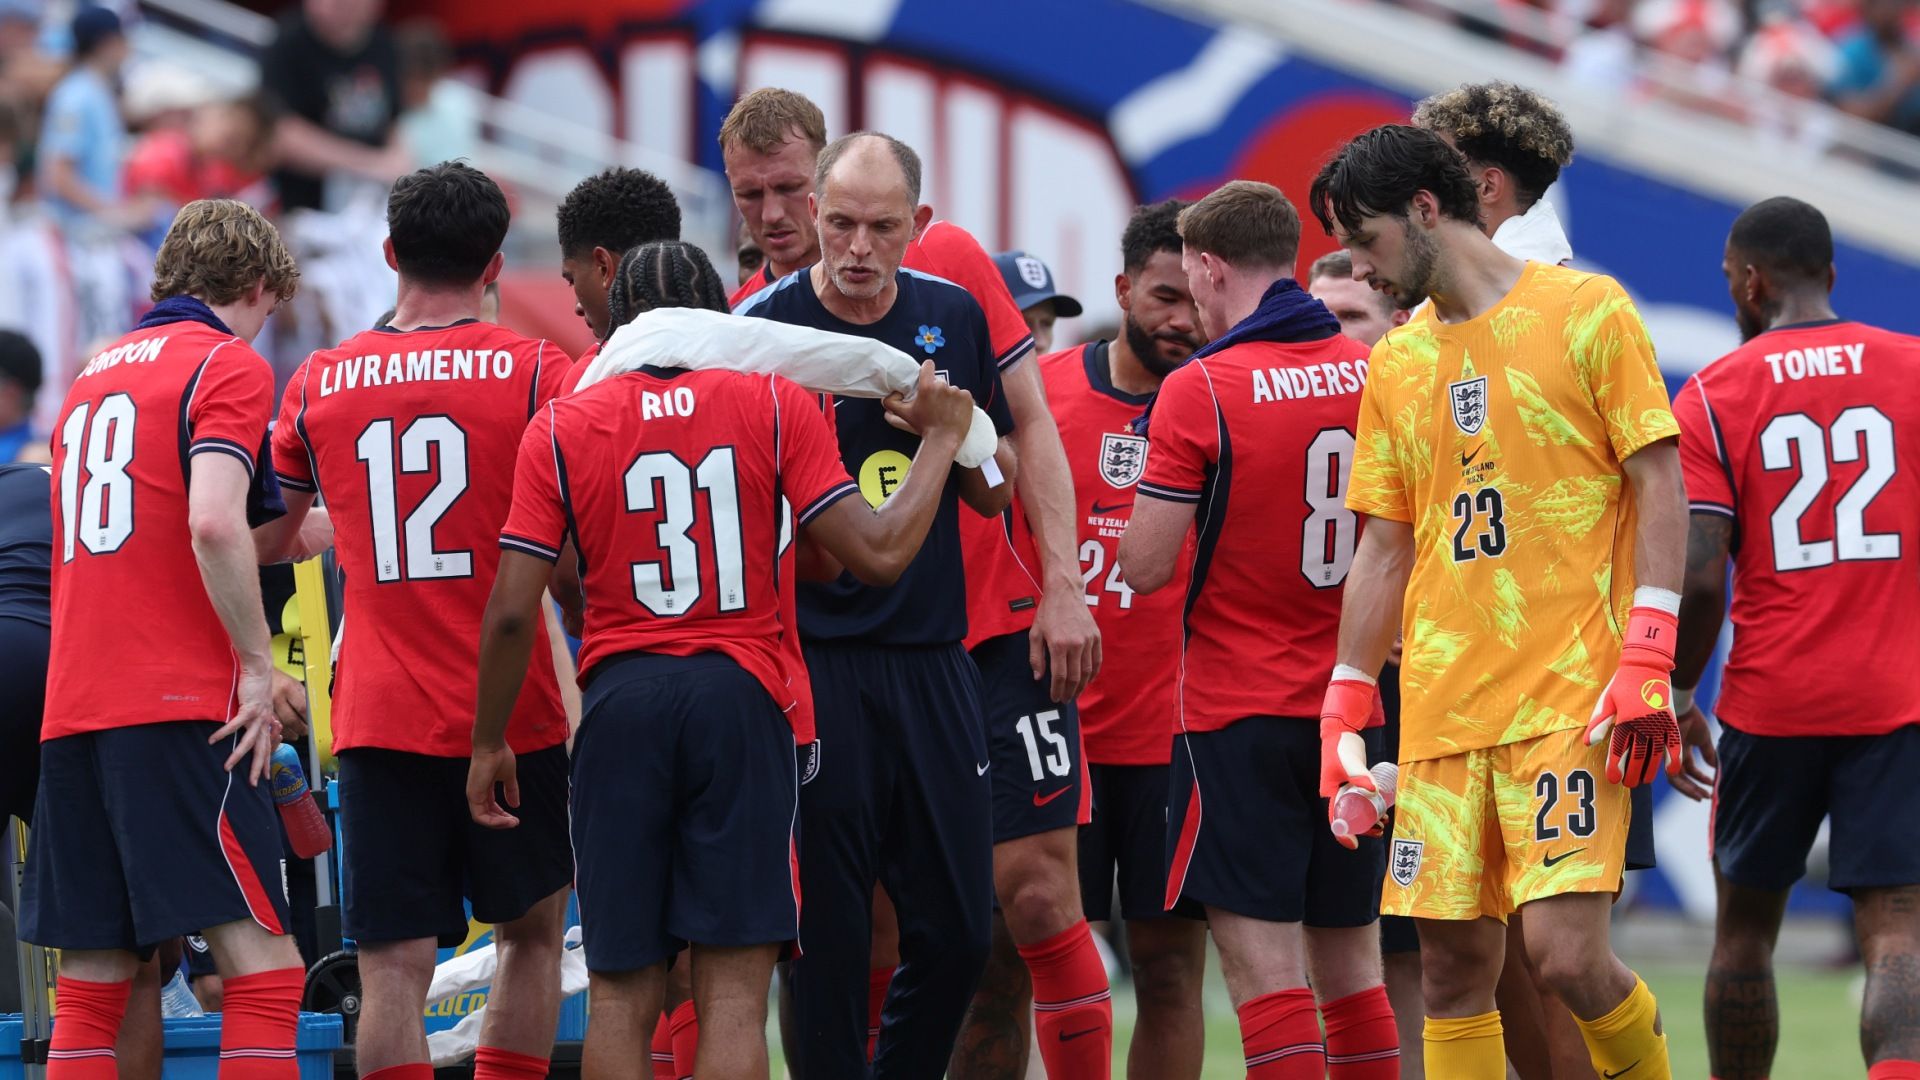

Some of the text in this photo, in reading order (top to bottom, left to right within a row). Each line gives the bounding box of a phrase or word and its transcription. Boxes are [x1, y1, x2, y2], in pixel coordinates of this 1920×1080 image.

[320, 349, 514, 397] LIVRAMENTO
[1252, 358, 1369, 404] ANDERSO
[1764, 343, 1865, 383] TONEY
[641, 387, 695, 420] RIO
[59, 391, 138, 565] 18
[355, 413, 474, 584] 12
[1301, 425, 1358, 590] 8
[1759, 404, 1902, 574] 22
[622, 444, 747, 618] 31
[1087, 516, 1129, 528] NEW ZEALA
[1453, 487, 1507, 563] 23
[1079, 540, 1136, 609] 24
[1015, 709, 1071, 781] 15
[1536, 769, 1597, 842] 23
